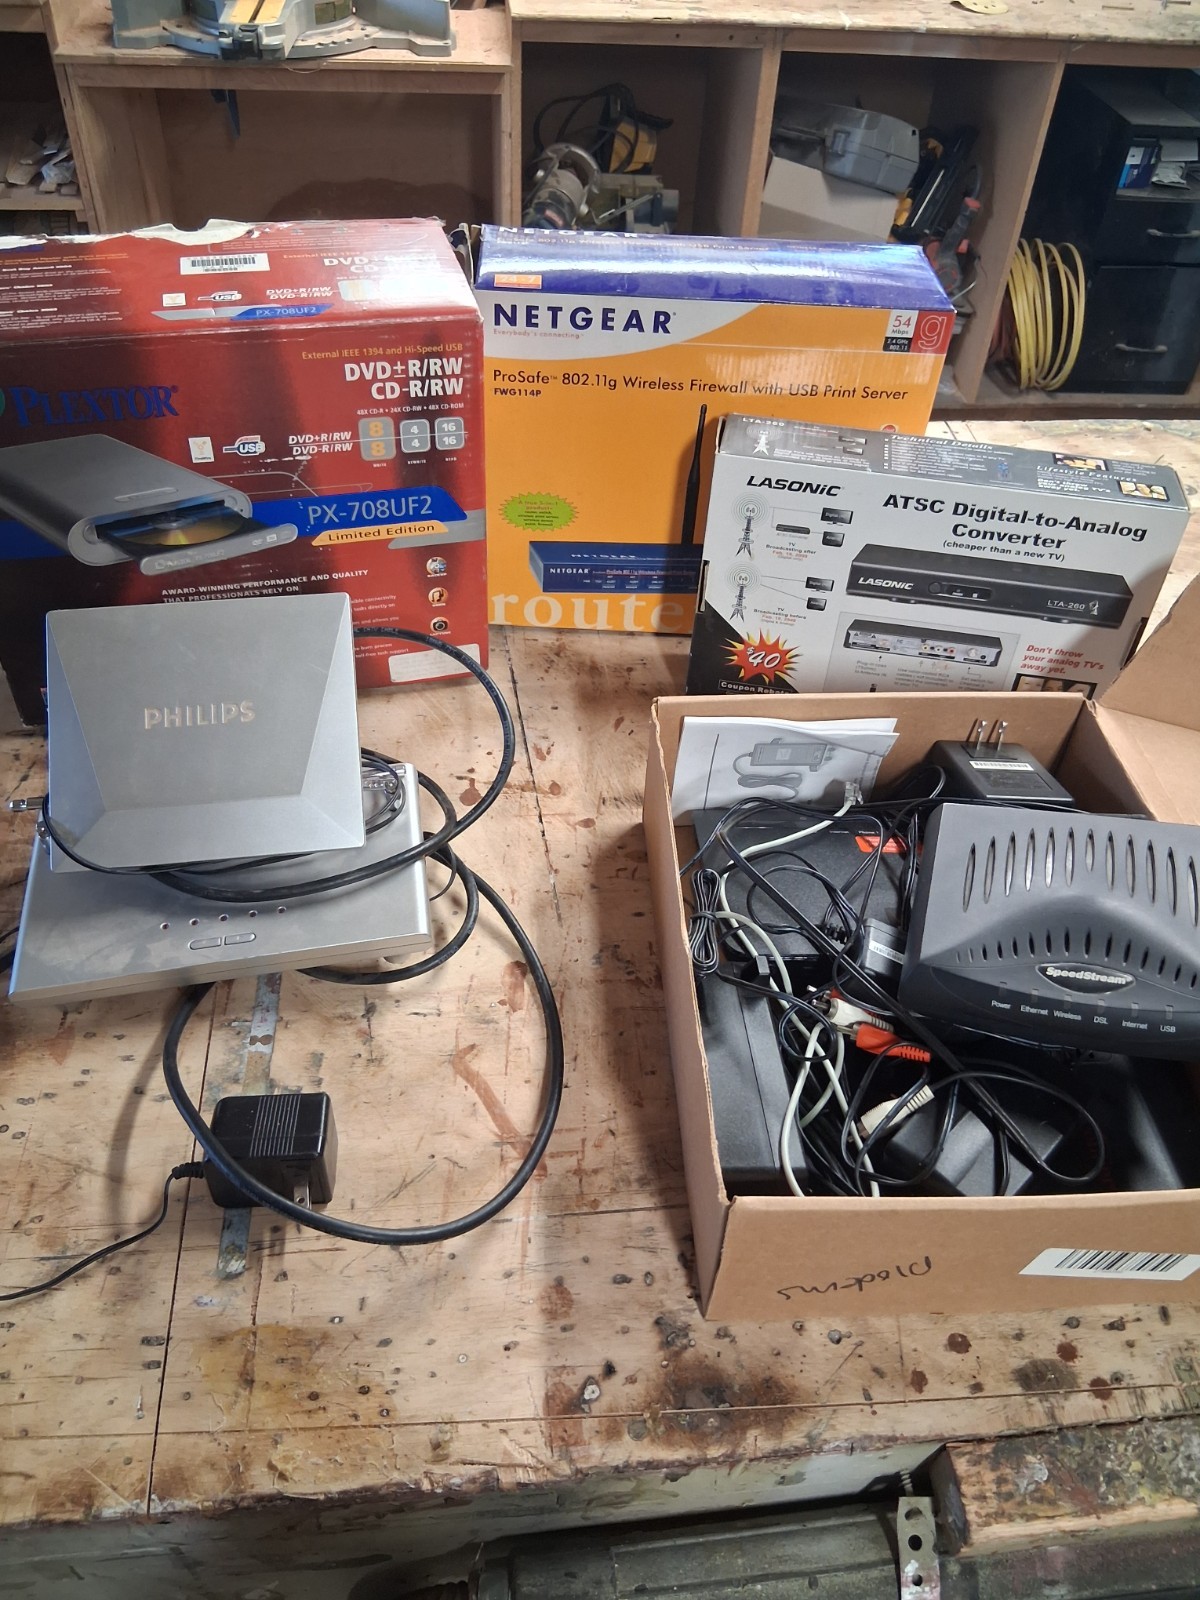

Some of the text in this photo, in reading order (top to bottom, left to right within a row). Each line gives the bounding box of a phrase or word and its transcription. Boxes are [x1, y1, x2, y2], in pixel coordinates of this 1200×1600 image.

[256, 306, 317, 316] PX-708UF2
[494, 303, 672, 334] NETGEAR
[893, 315, 911, 328] 54
[918, 314, 947, 349] g
[302, 343, 463, 360] External IEEE 1394 and Hi-Speed USB
[371, 378, 464, 400] CD-R/RW
[494, 387, 542, 397] FWG114P
[561, 372, 617, 391] 802.11g
[623, 375, 685, 391] Wireless
[690, 378, 748, 394] Firewall
[752, 381, 783, 396] with
[788, 383, 819, 397] USB
[823, 385, 857, 398] Print
[860, 386, 909, 400] Server
[8, 385, 180, 428] PLEXTOR
[402, 405, 422, 413] CD-RW
[440, 402, 465, 410] CD-ROM
[369, 421, 384, 437] 8
[410, 425, 419, 434] 4
[441, 422, 456, 432] 16
[288, 431, 352, 445] DVD+R/RW
[411, 439, 420, 448] 4
[442, 435, 457, 445] 16
[239, 442, 263, 454] USB
[293, 442, 353, 457] DVD-R/RW
[370, 441, 386, 456] 8
[308, 495, 433, 525] PX-708UF2
[883, 494, 1148, 543] ATSC Digital-to-Analog
[327, 523, 436, 543] Limited Edition
[951, 524, 1067, 549] Converter
[942, 540, 987, 552] (cheaper
[989, 545, 1012, 555] than
[1023, 551, 1045, 560] new
[1048, 553, 1066, 563] TV)
[161, 569, 369, 596] AWARD-WINNING PERFORMANCE AND QUALITY
[163, 585, 300, 604] THAT PROFESSIONALS RELY ON
[1047, 600, 1086, 611] LTA-260
[746, 646, 781, 669] $40
[1026, 645, 1084, 658] Don't throw
[1020, 663, 1066, 674] away yet.
[1023, 654, 1105, 670] your analog TV's
[720, 681, 756, 692] Coupon
[144, 700, 256, 730] PHILIPS
[1045, 965, 1128, 986] SpeedStream
[991, 1000, 1012, 1010] Power
[1020, 1004, 1049, 1016] Ethernet
[1053, 1009, 1082, 1021] Wireless
[1093, 1015, 1109, 1025] DSL
[1121, 1019, 1148, 1030] Internet
[1160, 1024, 1177, 1034] USB
